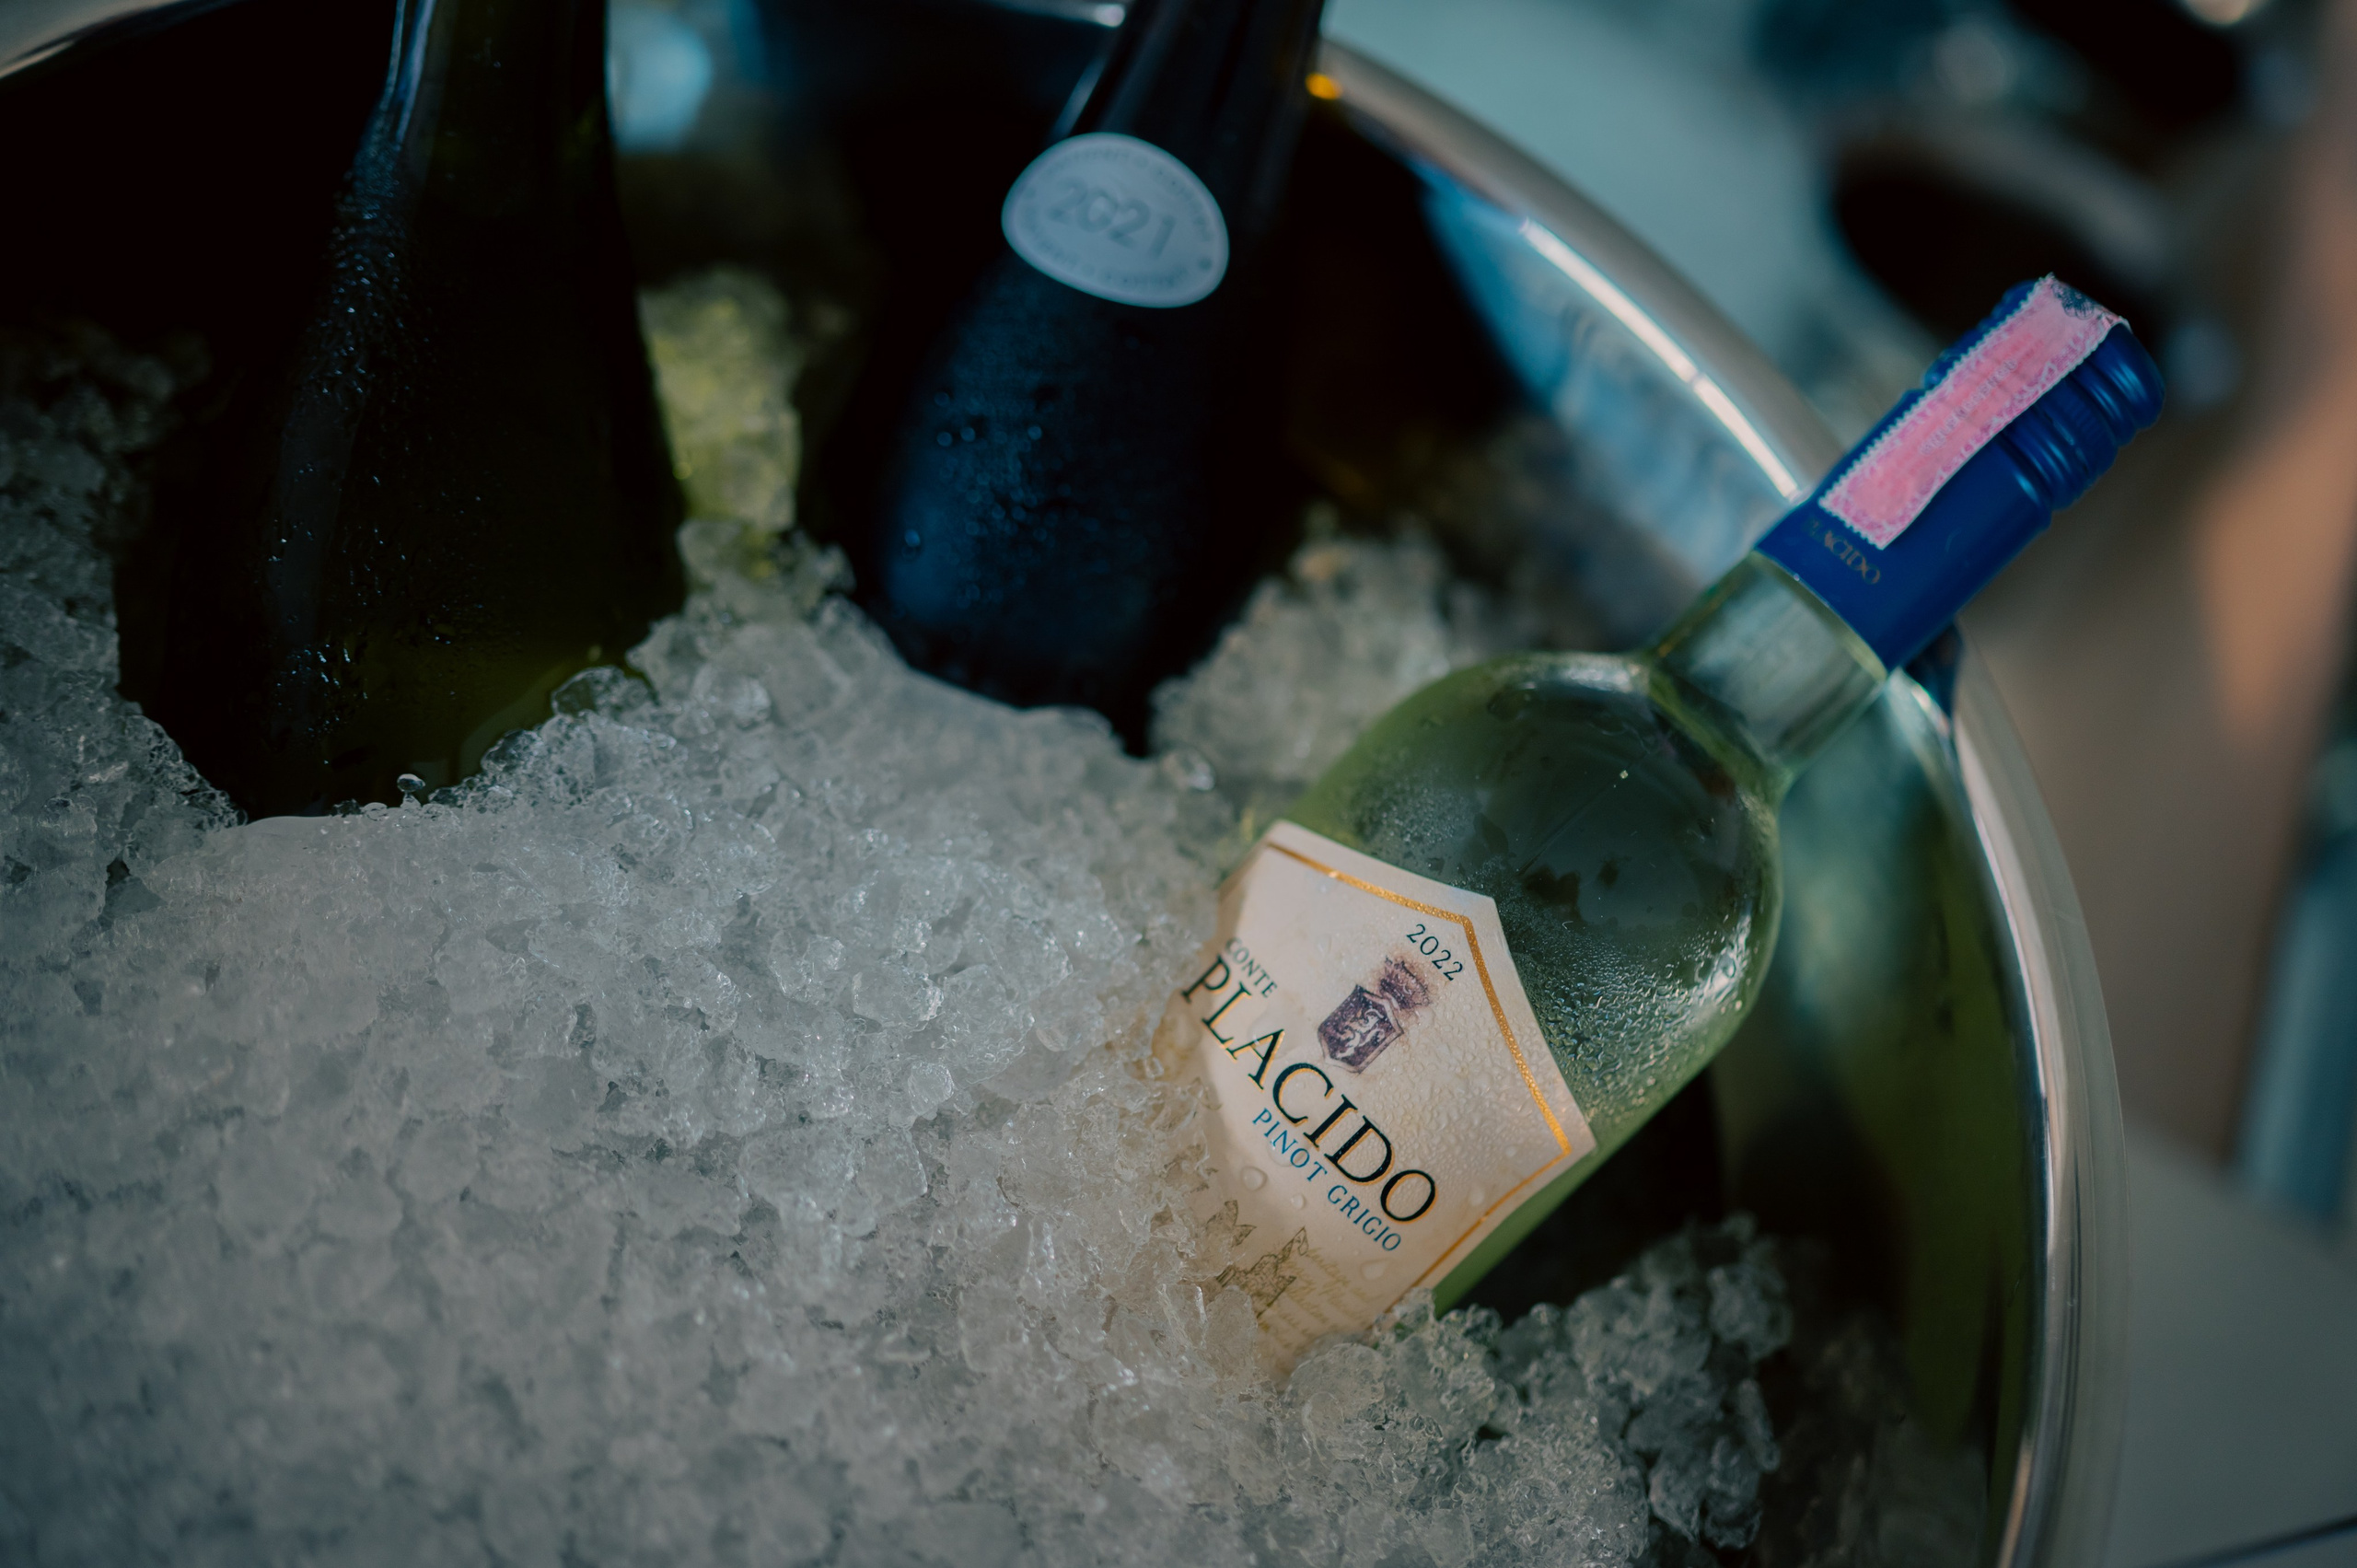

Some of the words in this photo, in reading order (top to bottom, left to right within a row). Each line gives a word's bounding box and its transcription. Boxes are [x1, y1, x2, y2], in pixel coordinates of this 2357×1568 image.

[1047, 176, 1177, 260] 2021
[1802, 518, 1881, 585] ACIDO
[1225, 936, 1278, 999] CONTE
[1406, 923, 1464, 981] 2022
[1181, 952, 1438, 1225] PLACIDO
[1252, 1107, 1328, 1182] PINOT
[1327, 1184, 1402, 1252] GRIGIO
